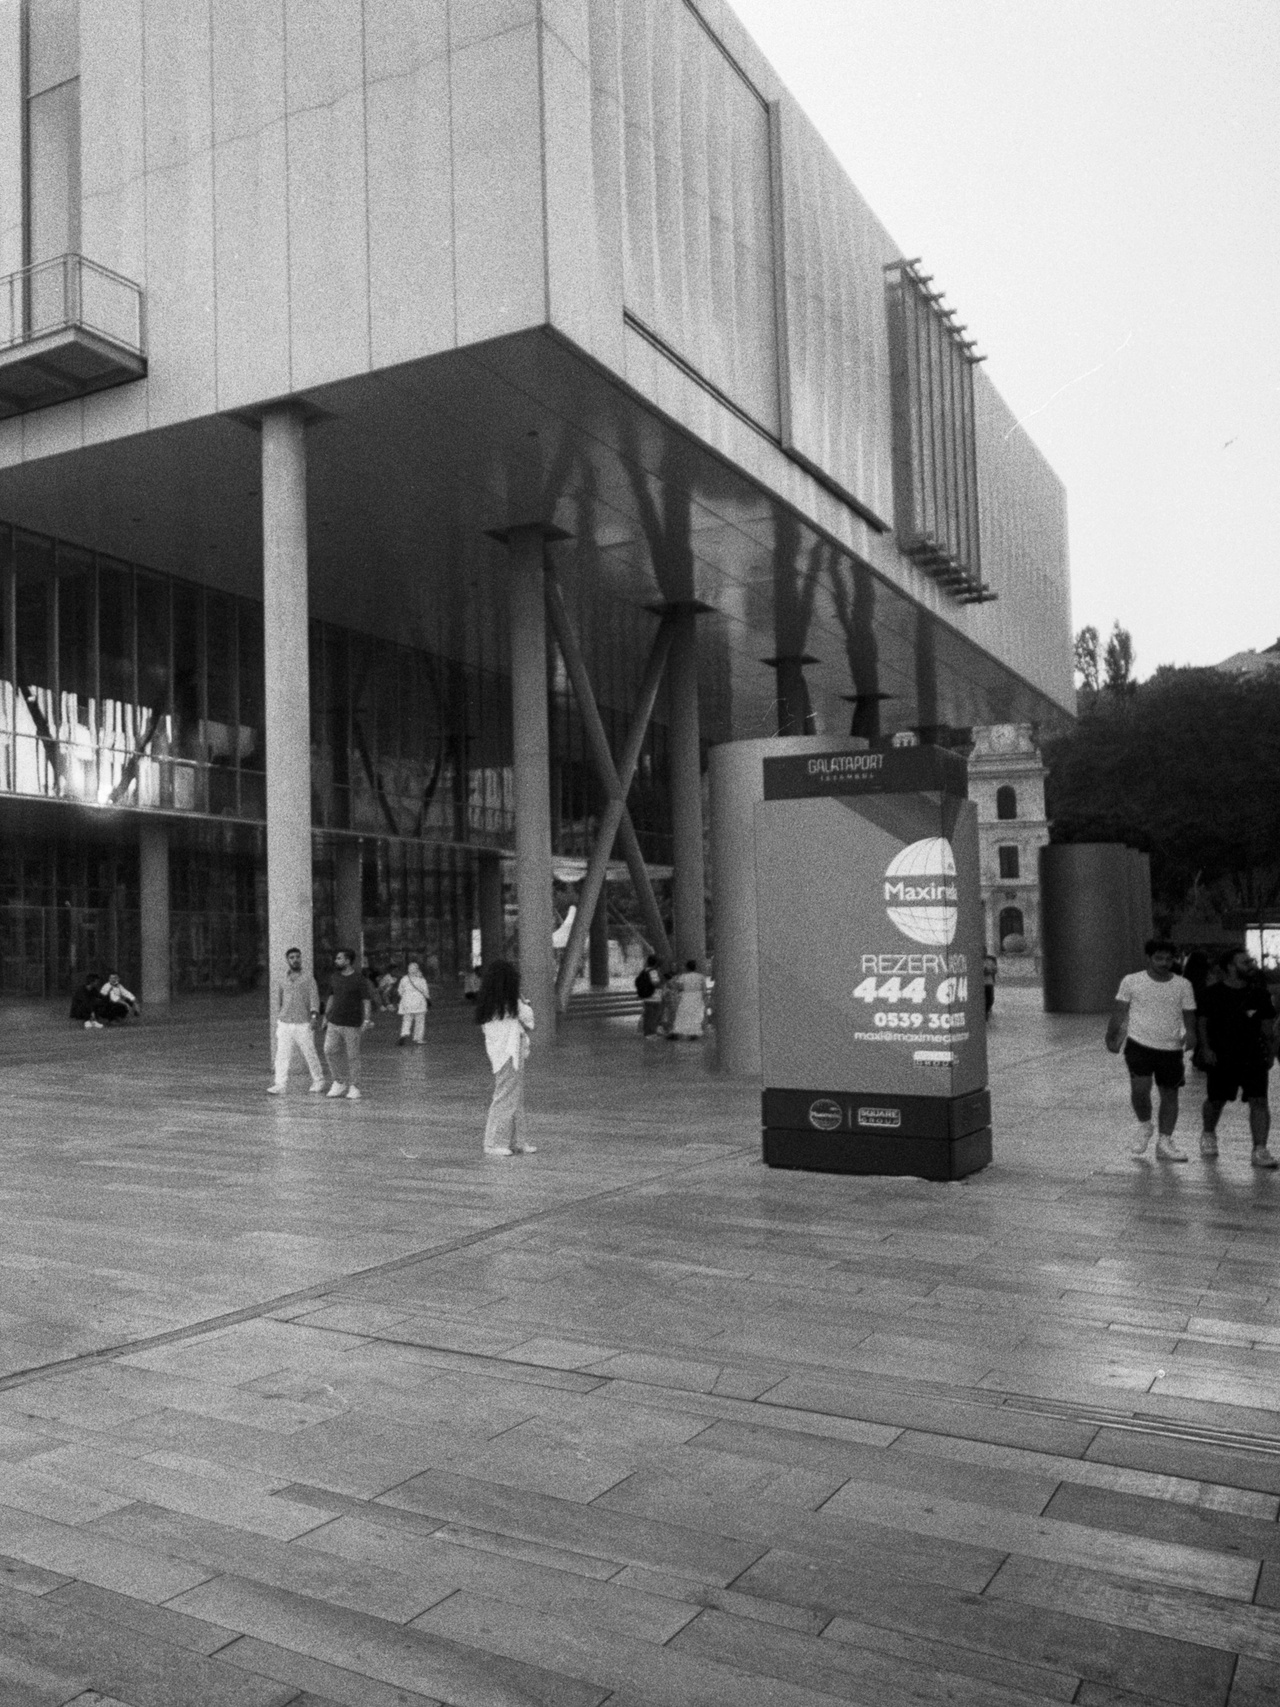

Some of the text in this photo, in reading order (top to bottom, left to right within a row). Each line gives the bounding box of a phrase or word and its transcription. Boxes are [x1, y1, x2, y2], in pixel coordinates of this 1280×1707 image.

[808, 754, 885, 774] GALATAPORT
[852, 976, 927, 1004] 444
[874, 1012, 924, 1028] 0539
